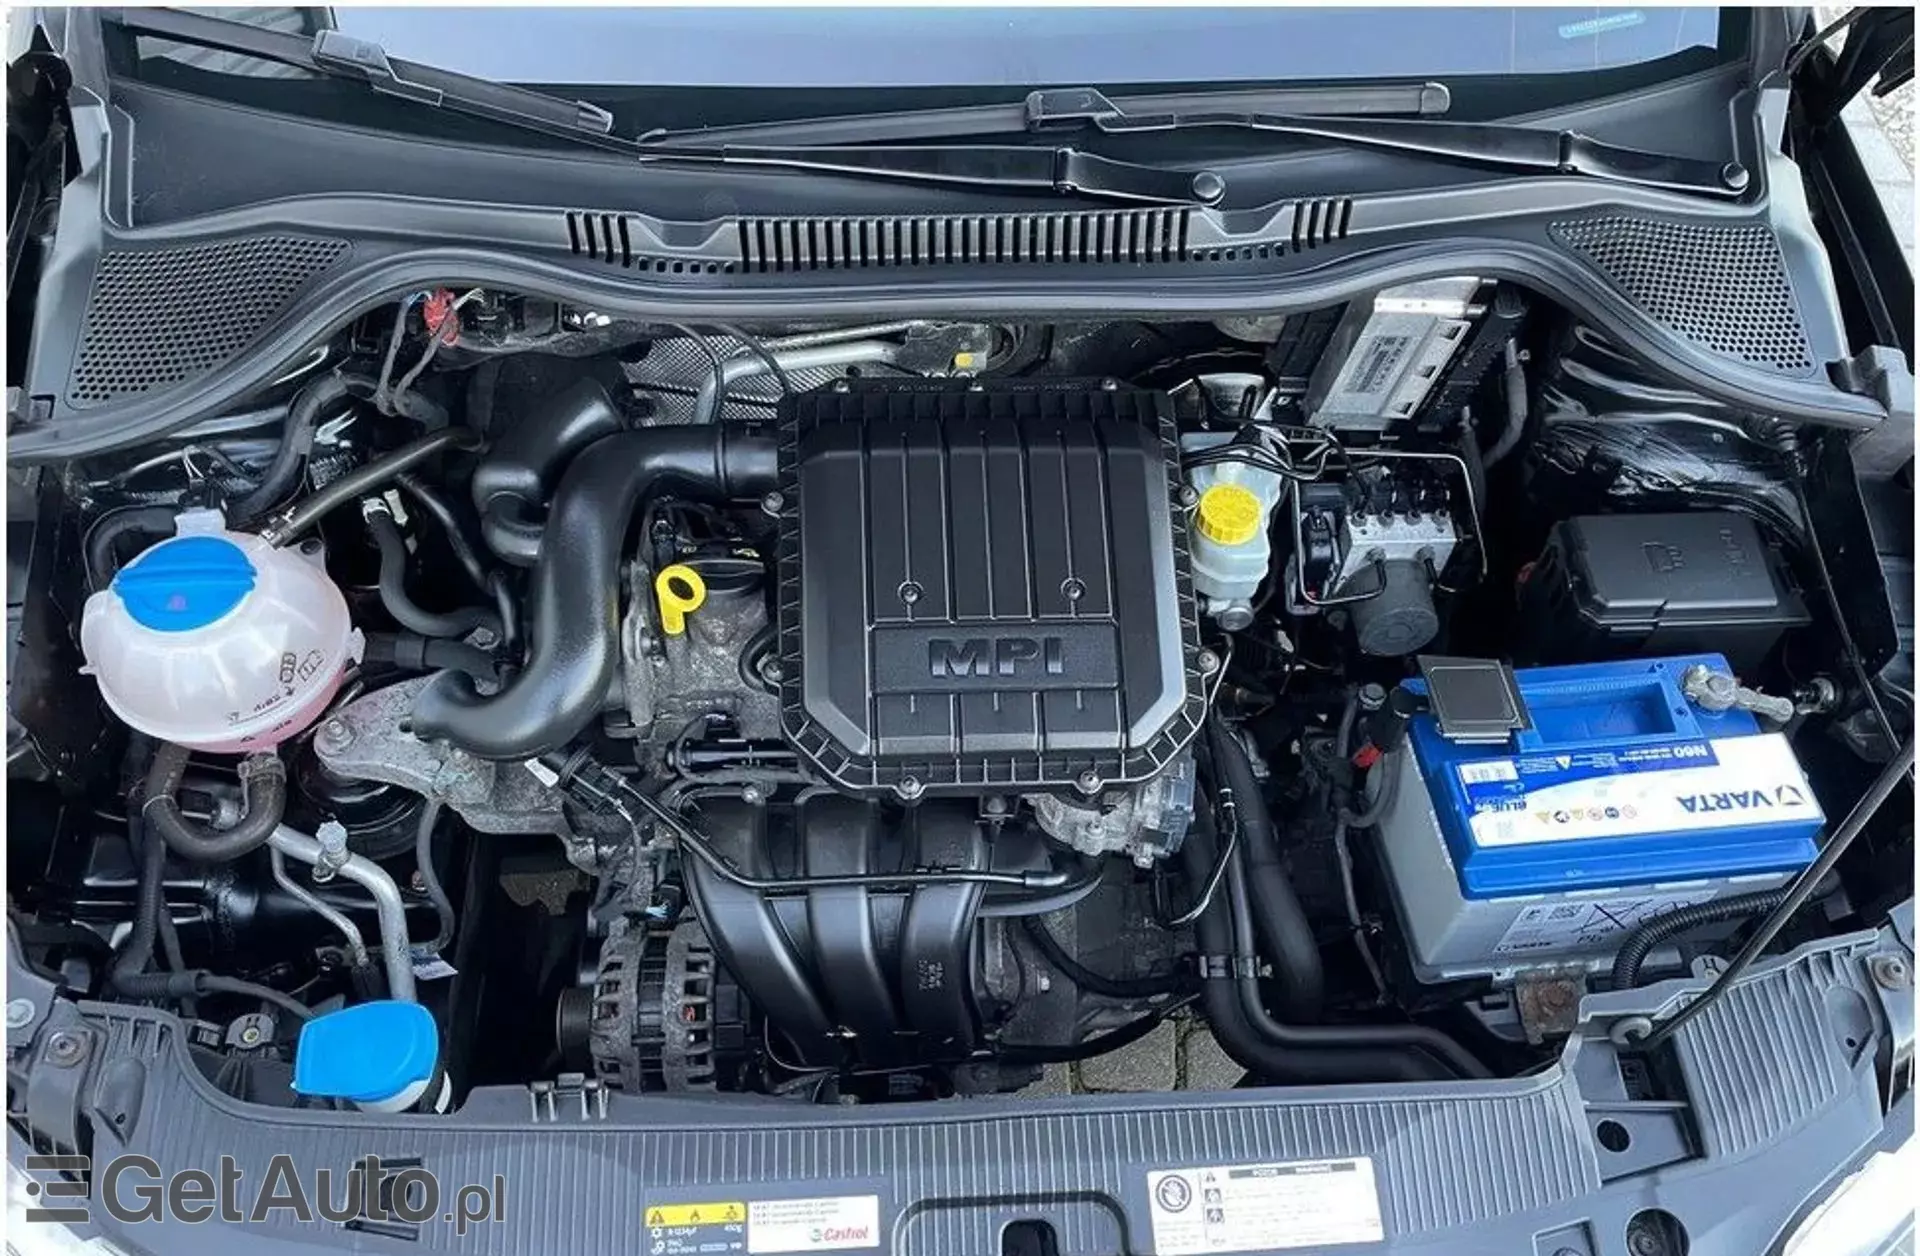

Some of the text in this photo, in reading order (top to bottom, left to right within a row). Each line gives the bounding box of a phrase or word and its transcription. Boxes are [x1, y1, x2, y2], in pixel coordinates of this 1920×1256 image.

[929, 637, 1062, 676] MPI
[1675, 791, 1773, 814] VARTA
[823, 1226, 869, 1243] Castrol
